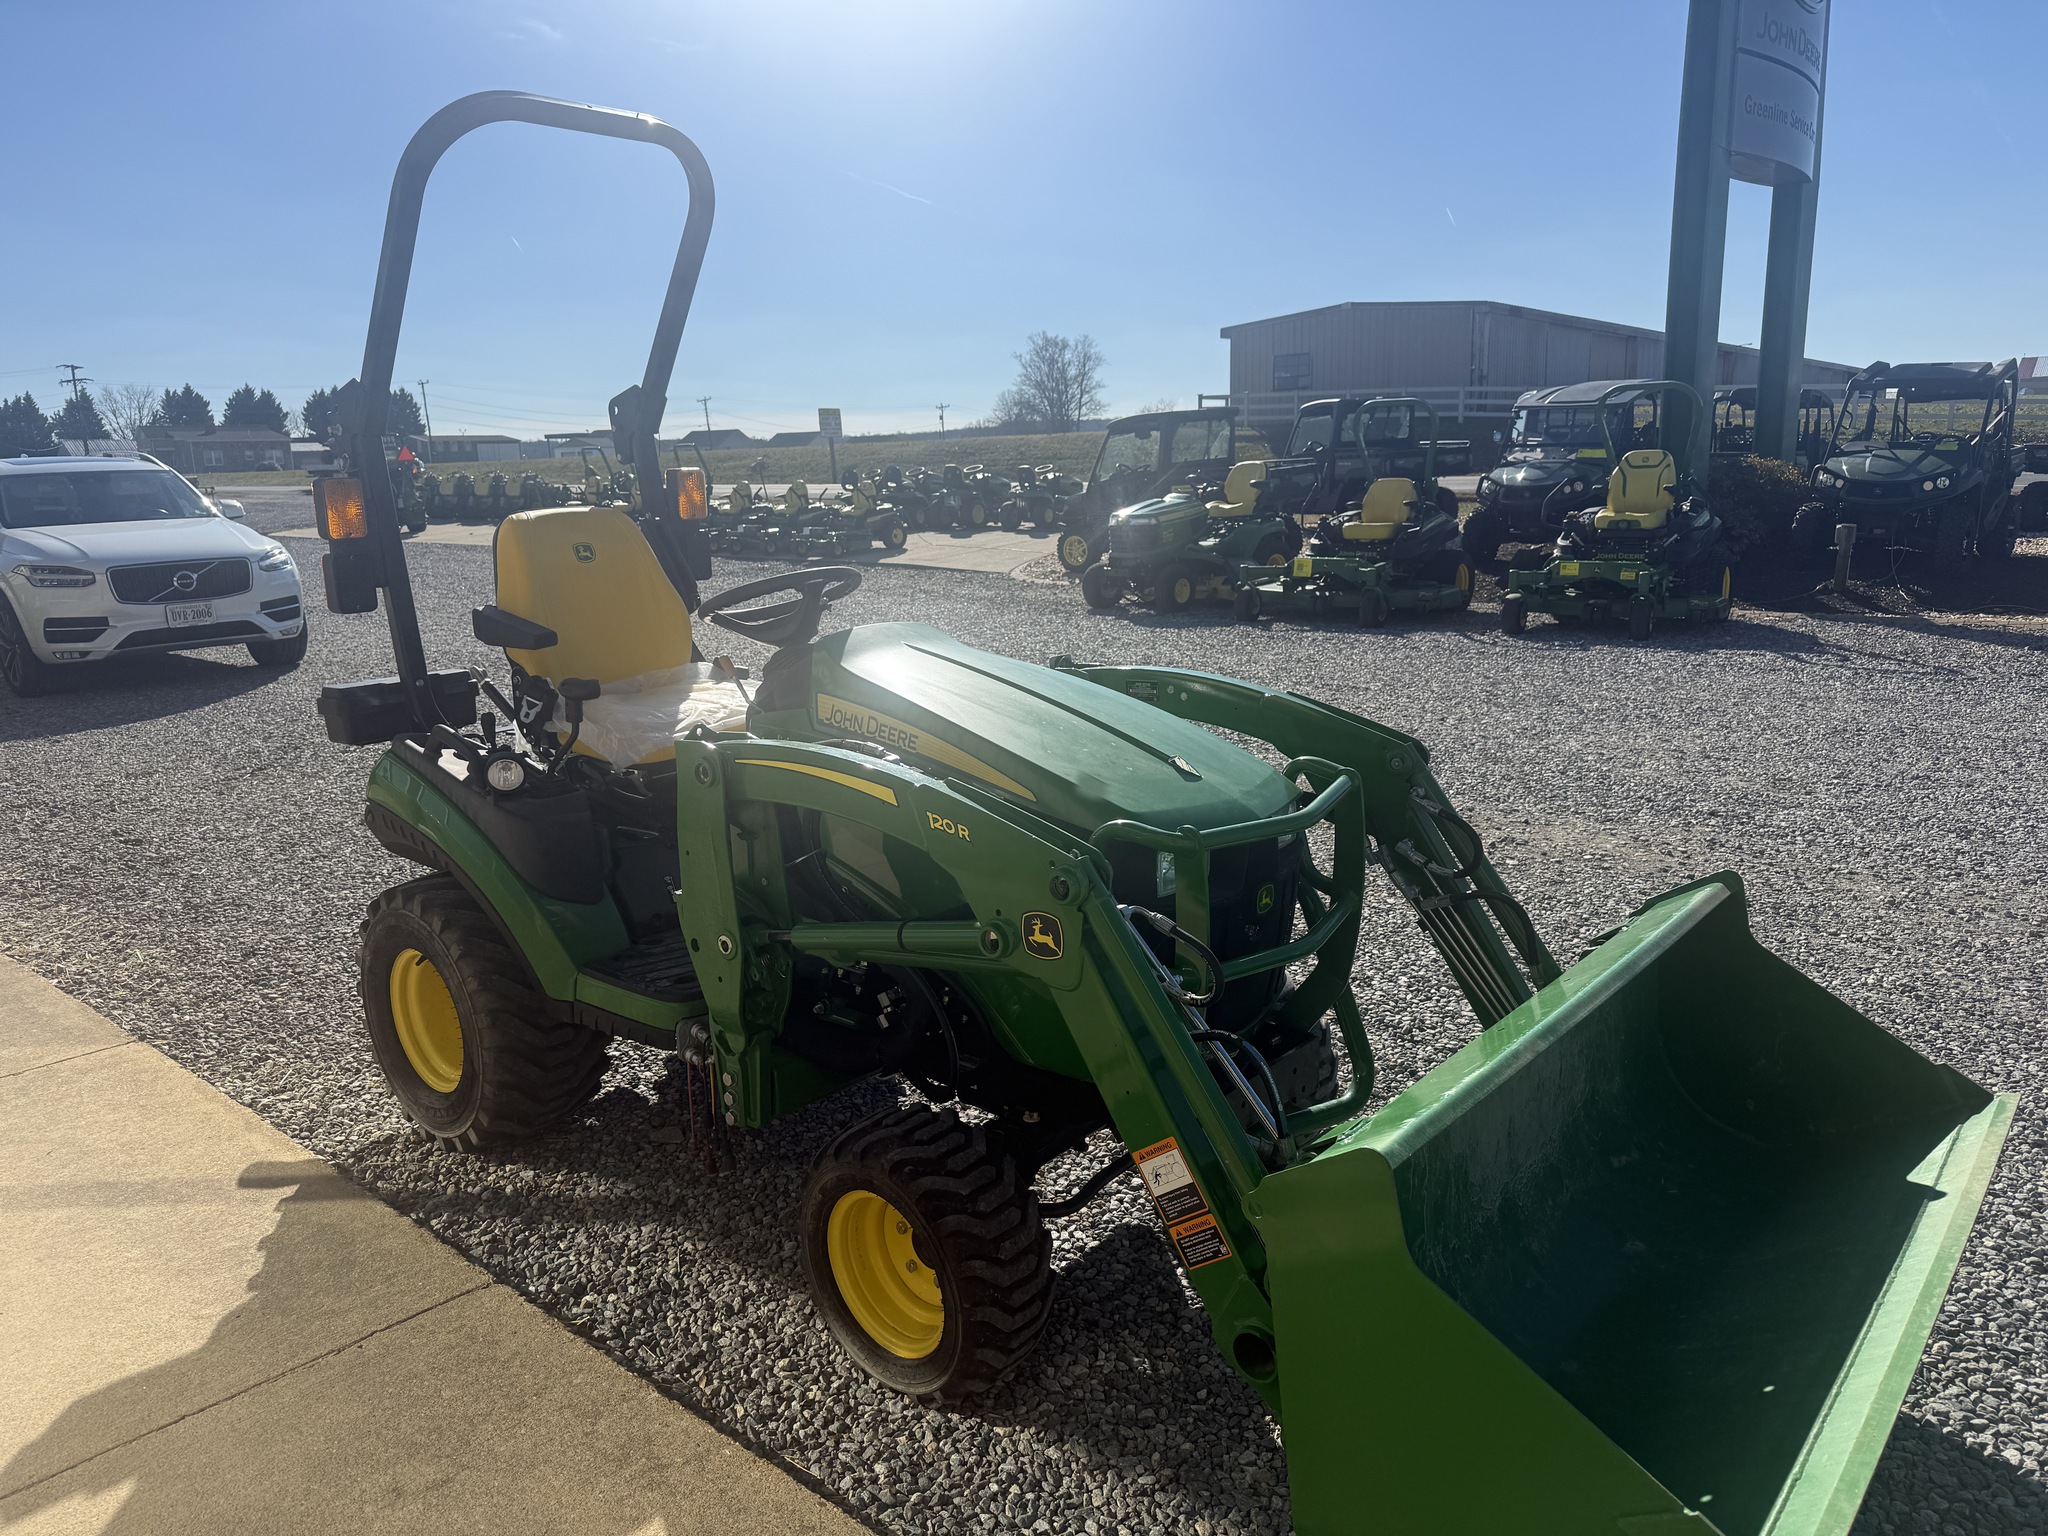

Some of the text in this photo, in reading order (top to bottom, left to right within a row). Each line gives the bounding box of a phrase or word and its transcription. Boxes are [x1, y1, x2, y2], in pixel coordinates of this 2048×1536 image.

[1756, 11, 1798, 53] JOHN
[1744, 94, 1788, 125] Greenline
[1789, 108, 1809, 137] Service
[1618, 552, 1645, 560] DEERE
[825, 704, 919, 751] JOHN DEERE
[1145, 1141, 1172, 1158] WARNING
[1182, 1218, 1212, 1234] WARNING
